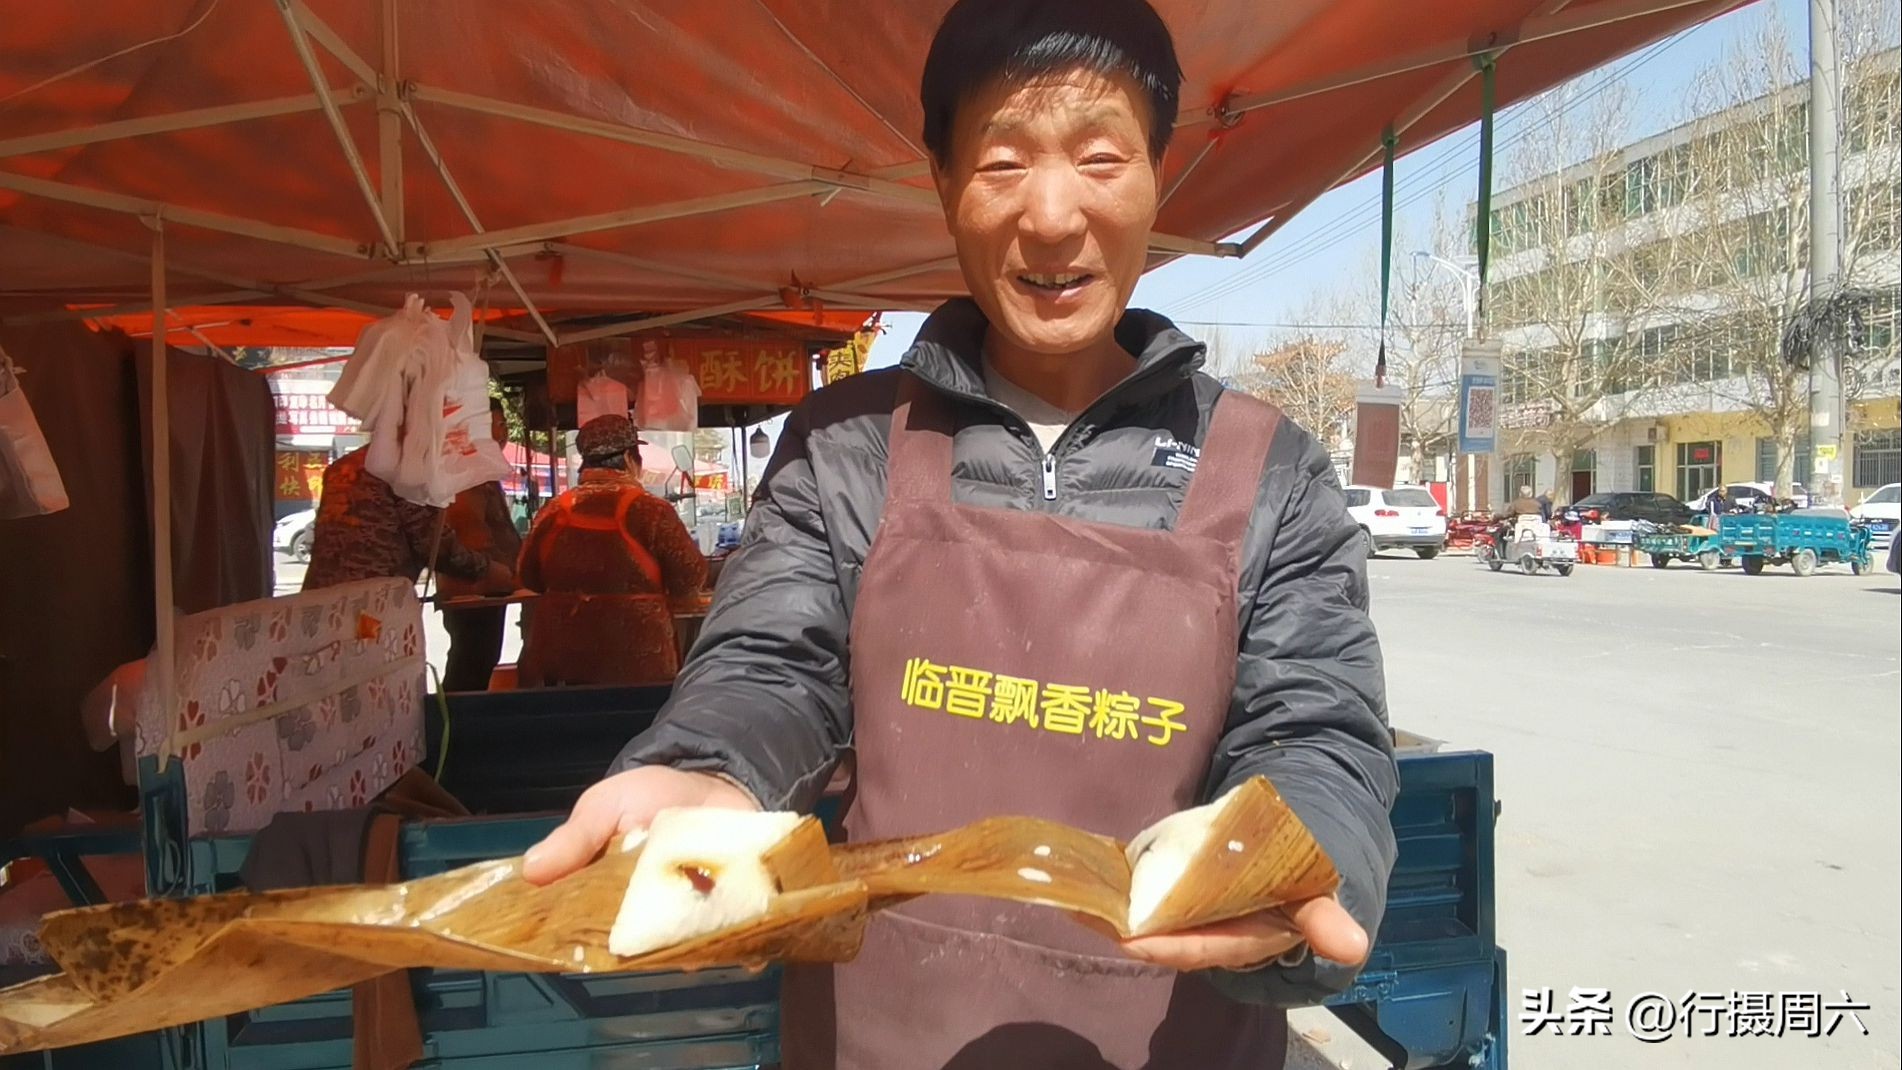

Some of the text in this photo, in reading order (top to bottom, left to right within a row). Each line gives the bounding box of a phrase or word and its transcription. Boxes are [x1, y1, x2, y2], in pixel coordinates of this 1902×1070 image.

[900, 657, 1187, 746] 临晋飘香粽子
